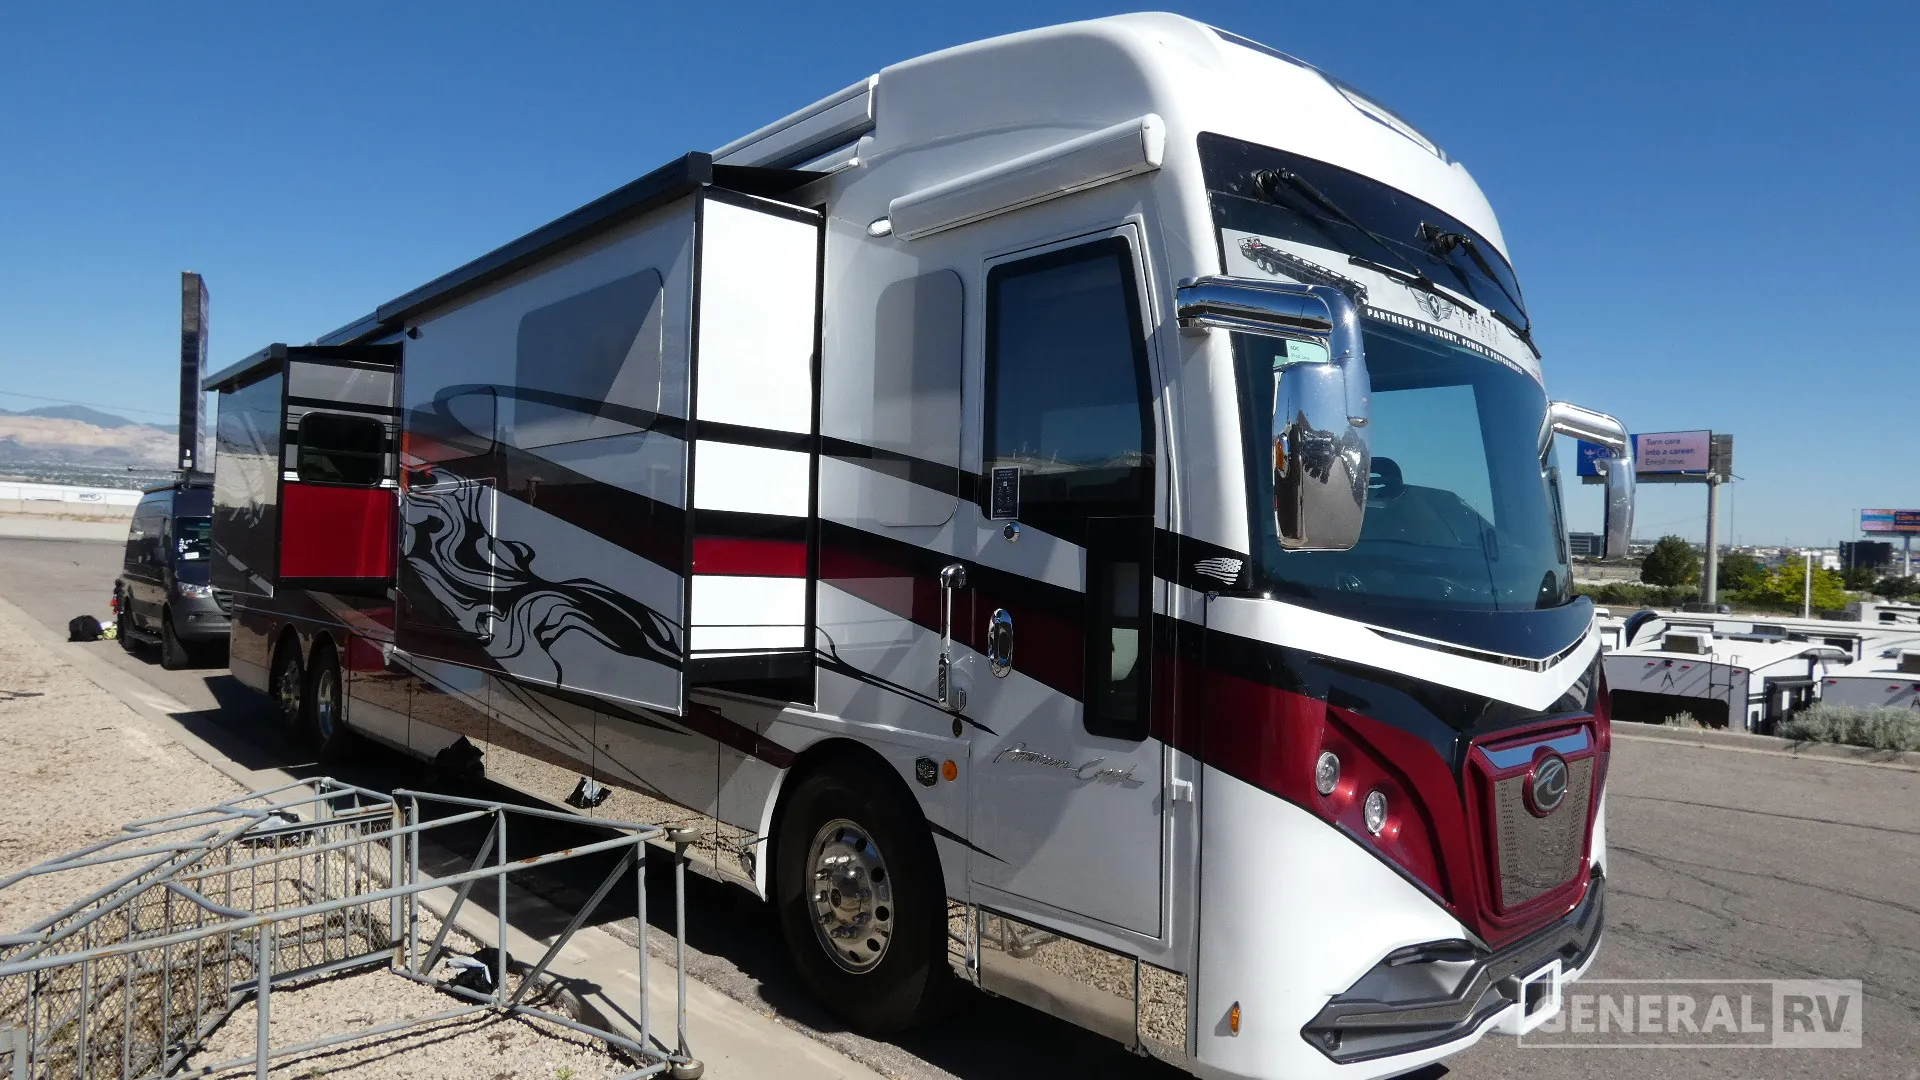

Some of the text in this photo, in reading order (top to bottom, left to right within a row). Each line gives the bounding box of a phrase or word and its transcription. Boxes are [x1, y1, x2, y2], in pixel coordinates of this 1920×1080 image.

[1367, 308, 1414, 328] PARTNERS
[1417, 322, 1427, 332] IN
[1429, 326, 1461, 345] LUXURY,
[1462, 338, 1484, 354] POWER
